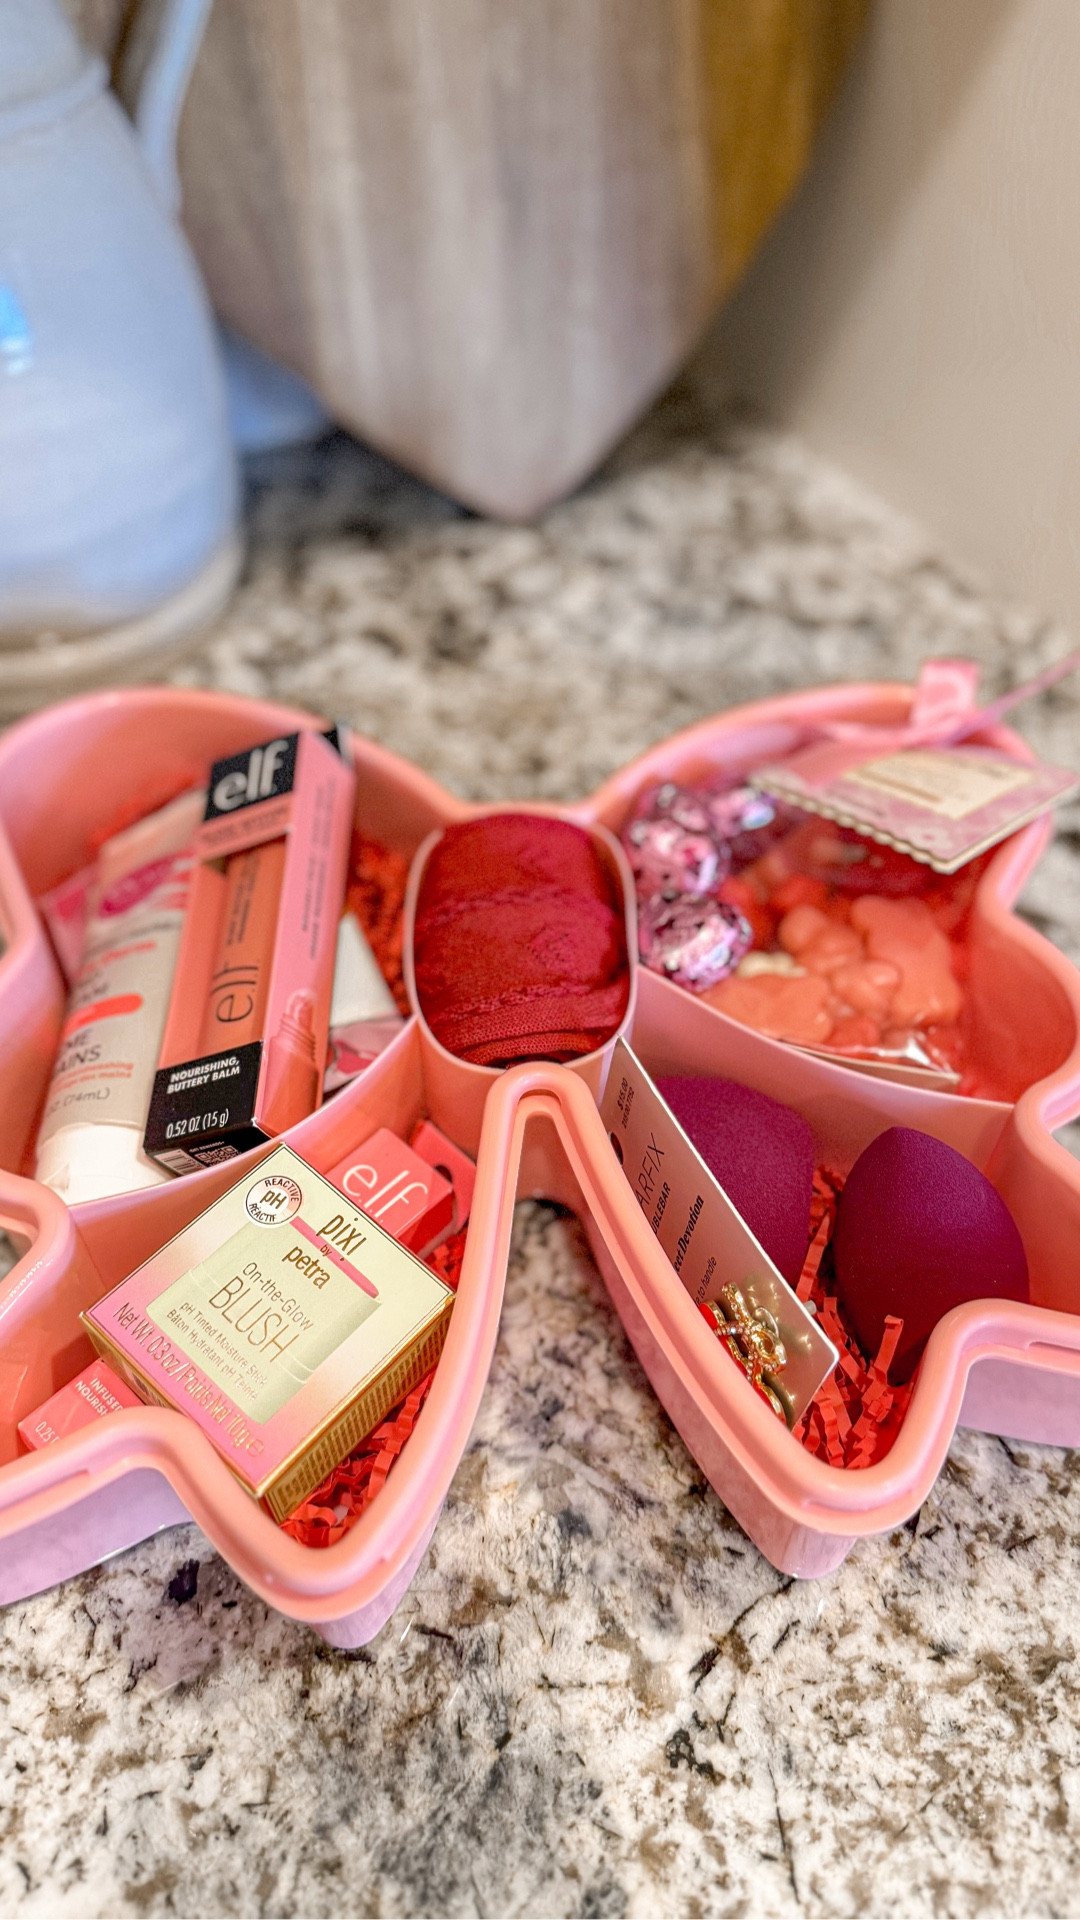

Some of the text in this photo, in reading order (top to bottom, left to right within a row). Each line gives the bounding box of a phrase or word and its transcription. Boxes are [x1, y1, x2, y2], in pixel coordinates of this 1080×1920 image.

[166, 1066, 240, 1094] BUTTERY BALM
[170, 1056, 240, 1083] NOURISHING,
[165, 1120, 187, 1139] 0.52
[188, 1115, 201, 1132] OZ
[635, 1132, 665, 1207] ARFIX
[259, 1190, 287, 1209] pH
[264, 1177, 299, 1202] REACTIVE
[651, 1181, 671, 1234] UBLEBAR
[316, 1214, 367, 1262] pixi
[677, 1195, 704, 1254] Devotion
[282, 1246, 331, 1289] petra
[320, 1244, 333, 1257] by
[701, 1256, 717, 1288] handle
[242, 1262, 314, 1331] On-the-Glow
[113, 1302, 140, 1329] Net
[208, 1276, 300, 1363] BLUSH
[179, 1302, 196, 1315] pH
[193, 1311, 219, 1337] Tinted
[215, 1333, 248, 1368] Moisture
[188, 1329, 225, 1368] Hydratant
[75, 1380, 109, 1416] NOURISH
[35, 1421, 56, 1442] 0.25
